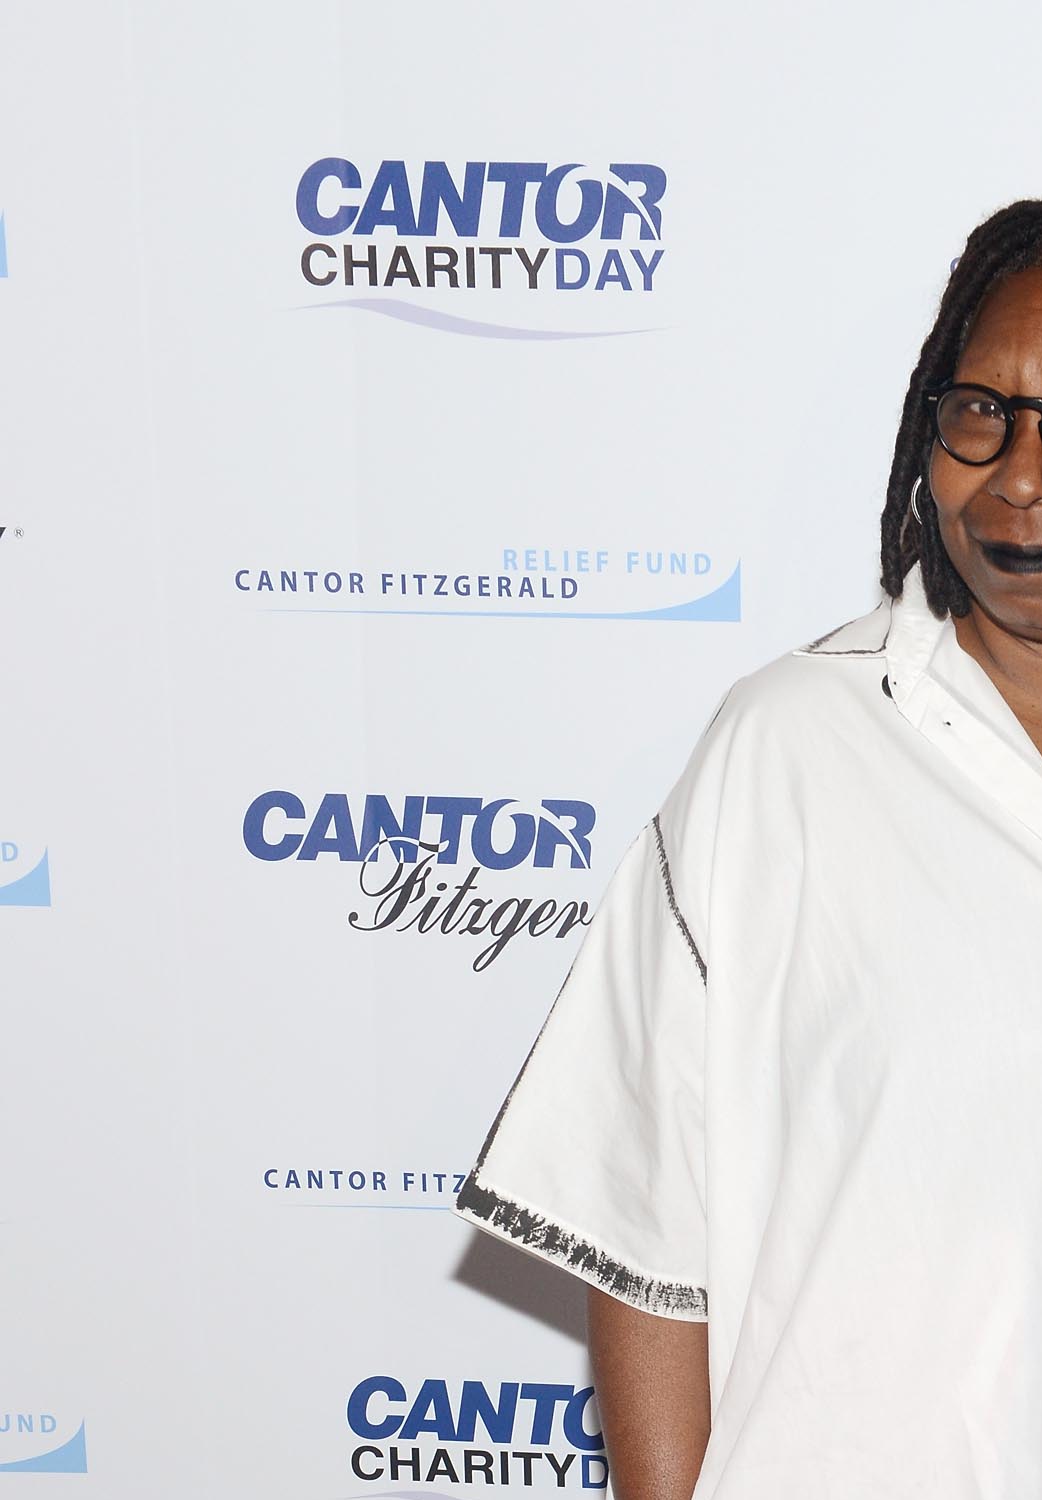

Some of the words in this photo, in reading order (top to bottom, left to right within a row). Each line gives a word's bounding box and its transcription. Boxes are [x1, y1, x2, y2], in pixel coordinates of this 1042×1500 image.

[296, 157, 667, 243] CANTOR
[503, 549, 609, 574] RELIEF
[627, 552, 713, 576] FUND
[234, 569, 365, 595] CANTOR
[381, 573, 580, 600] FITZGERALD
[242, 790, 596, 870] CANTOR
[264, 1168, 386, 1190] CANTOR
